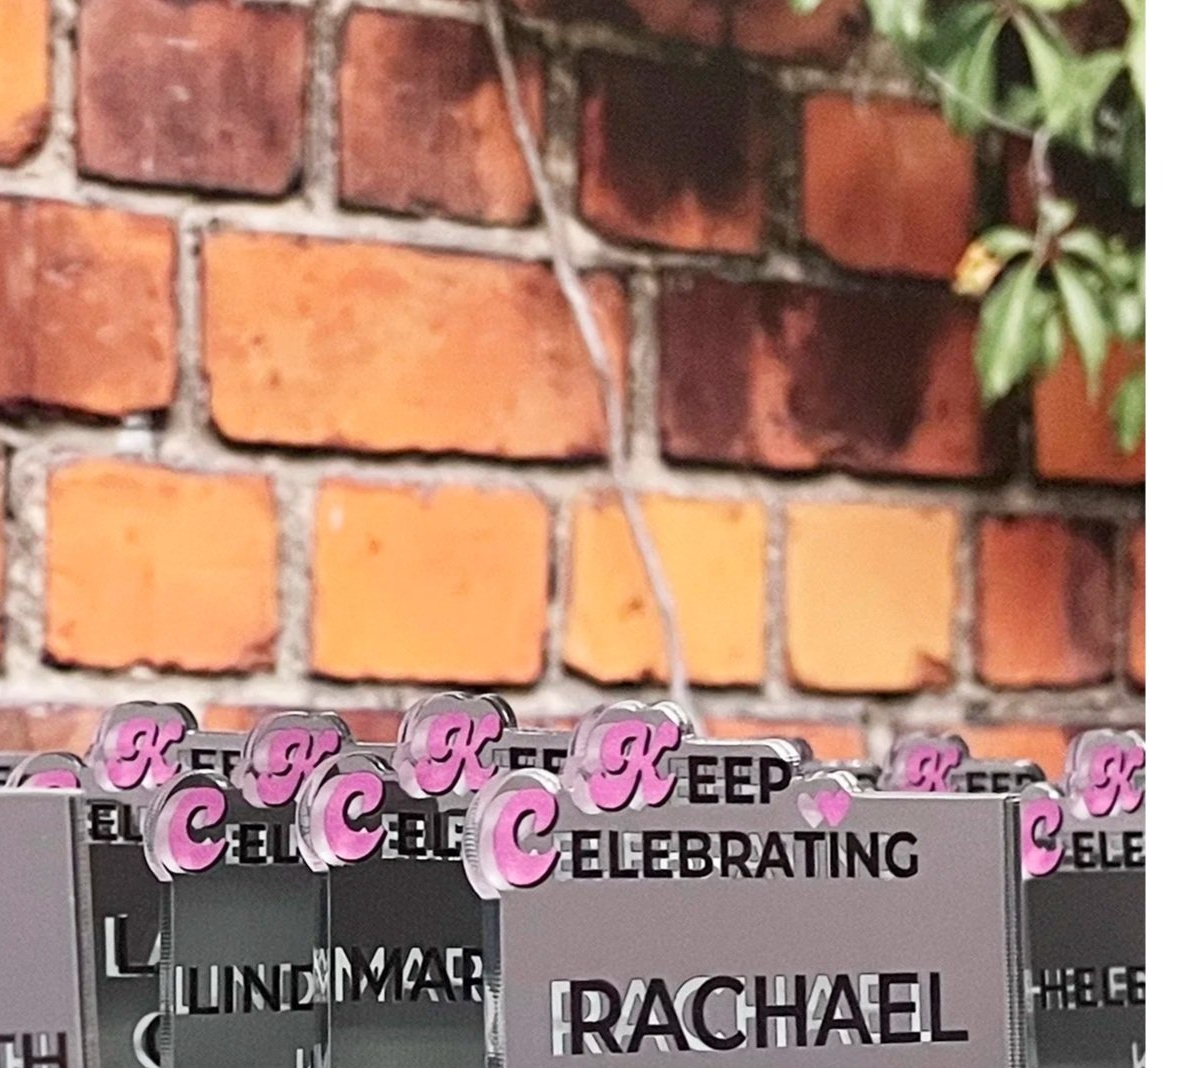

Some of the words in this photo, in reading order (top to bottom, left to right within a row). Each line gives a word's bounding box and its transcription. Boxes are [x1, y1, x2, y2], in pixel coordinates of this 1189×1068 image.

[589, 719, 794, 811] KEEP
[491, 788, 918, 888] CELEBRATING
[559, 972, 969, 1056] RACHAEL
